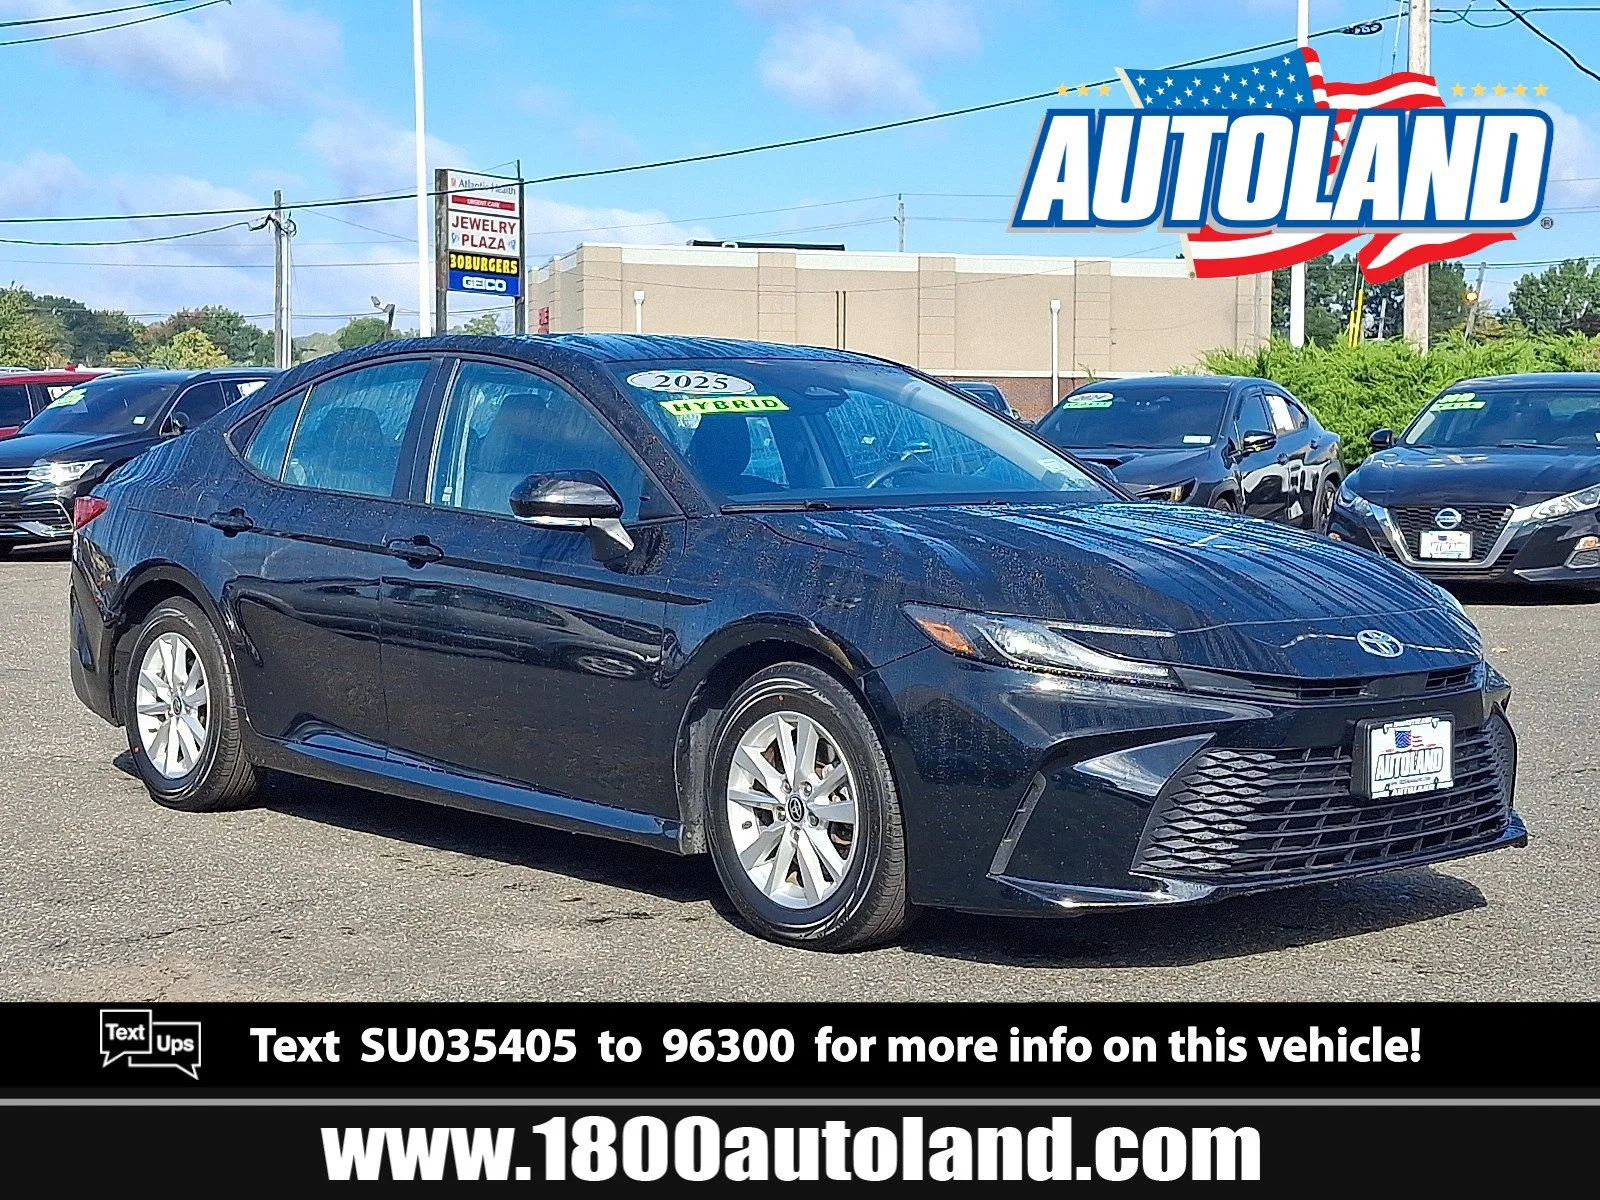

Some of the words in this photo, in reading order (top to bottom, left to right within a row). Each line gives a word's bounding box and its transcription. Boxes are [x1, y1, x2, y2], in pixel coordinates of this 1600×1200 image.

[452, 216, 517, 235] JEWELRY
[461, 234, 506, 251] PLAZA
[462, 275, 507, 292] GEICO
[654, 374, 728, 390] 2025
[672, 399, 779, 412] HYBRID
[1374, 747, 1443, 781] AUTOLAND
